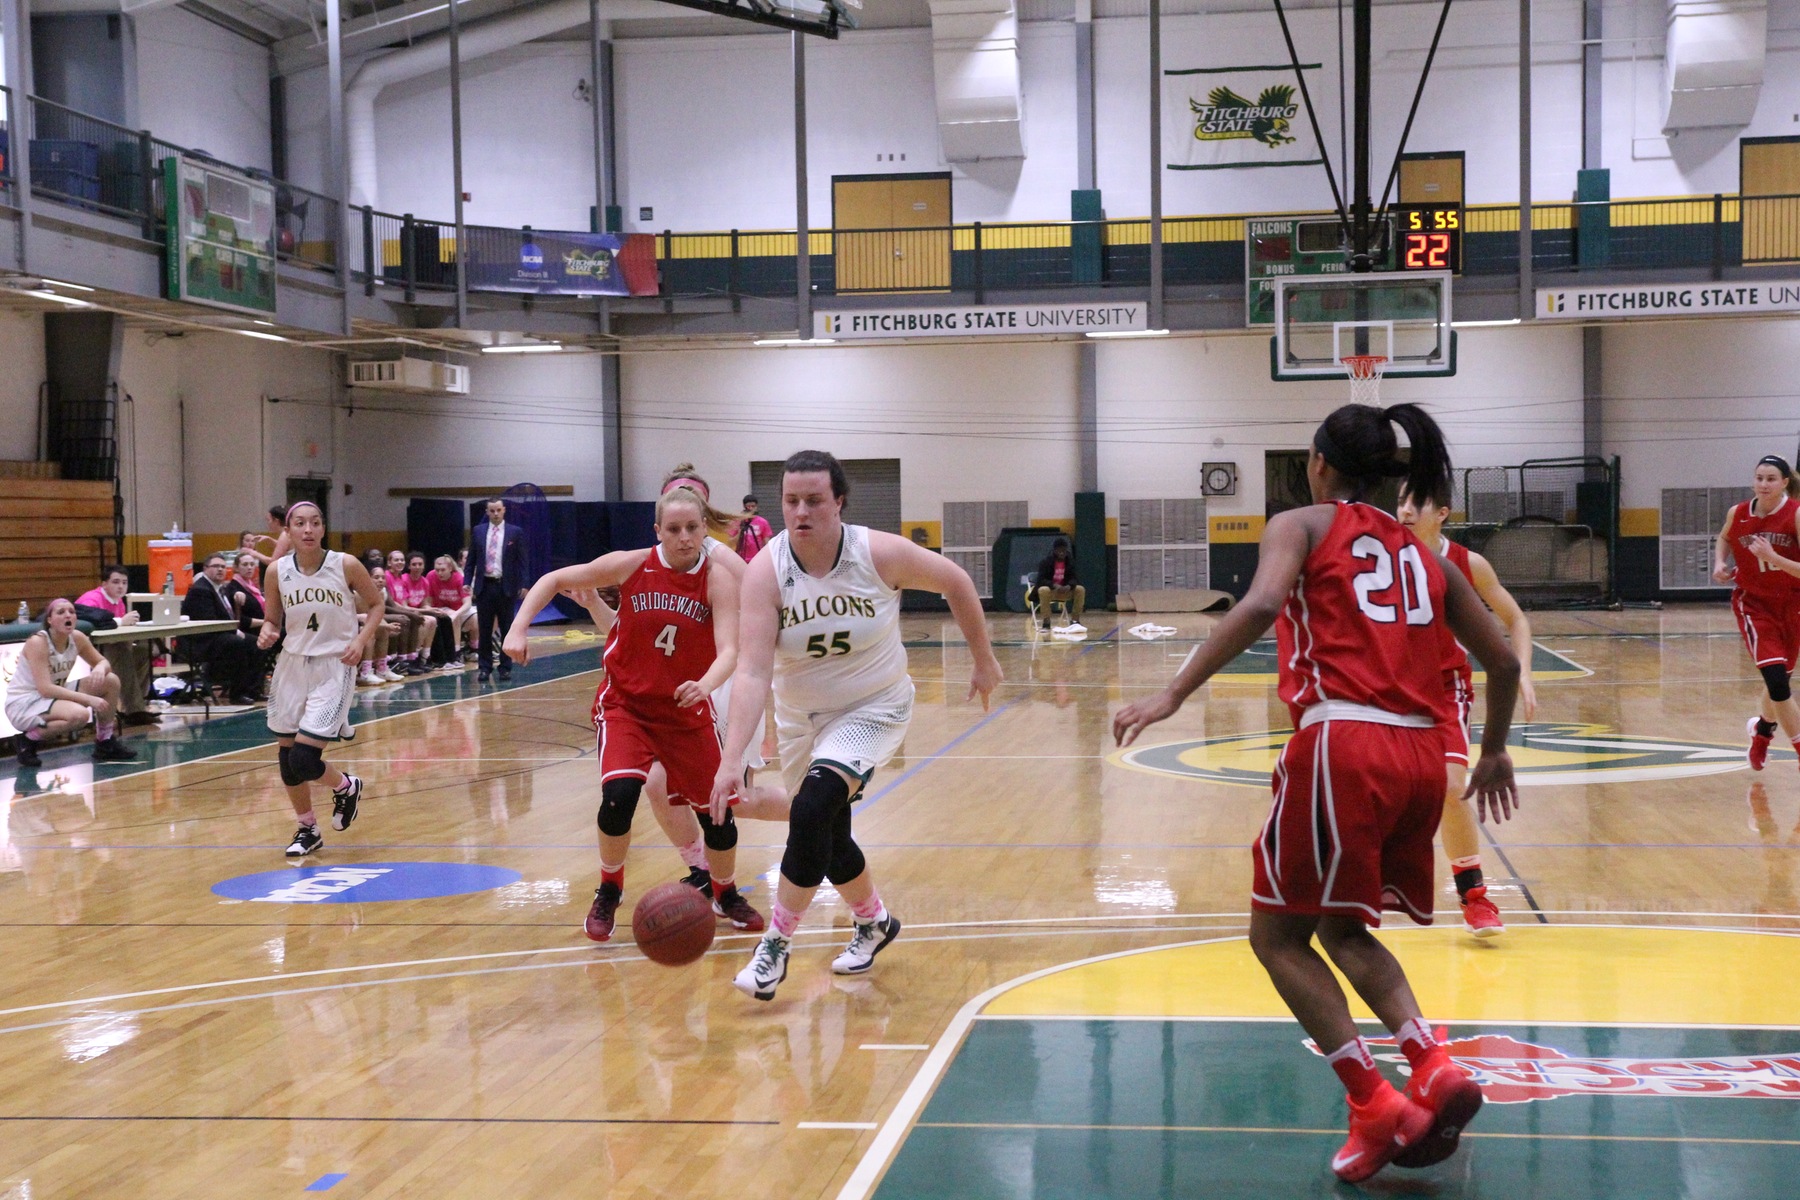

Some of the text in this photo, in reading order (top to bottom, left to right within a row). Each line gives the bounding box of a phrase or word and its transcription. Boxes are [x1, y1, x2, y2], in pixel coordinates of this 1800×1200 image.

[1198, 104, 1298, 120] FITCHBURG
[1202, 119, 1257, 133] STATE
[1252, 222, 1293, 235] FALCONS
[521, 255, 543, 264] NCAA
[1407, 233, 1450, 267] 22
[1266, 264, 1295, 275] BONUS
[1321, 263, 1347, 273] PERIO
[1577, 290, 1693, 311] FITCHBURG
[1700, 288, 1759, 306] STATE
[853, 308, 1137, 332] FITCHBURG STATE UNIVERSITY
[1350, 533, 1435, 626] 20
[306, 612, 319, 632] 4
[779, 594, 876, 631] FALCONS
[654, 624, 678, 657] 4
[806, 630, 852, 659] 55
